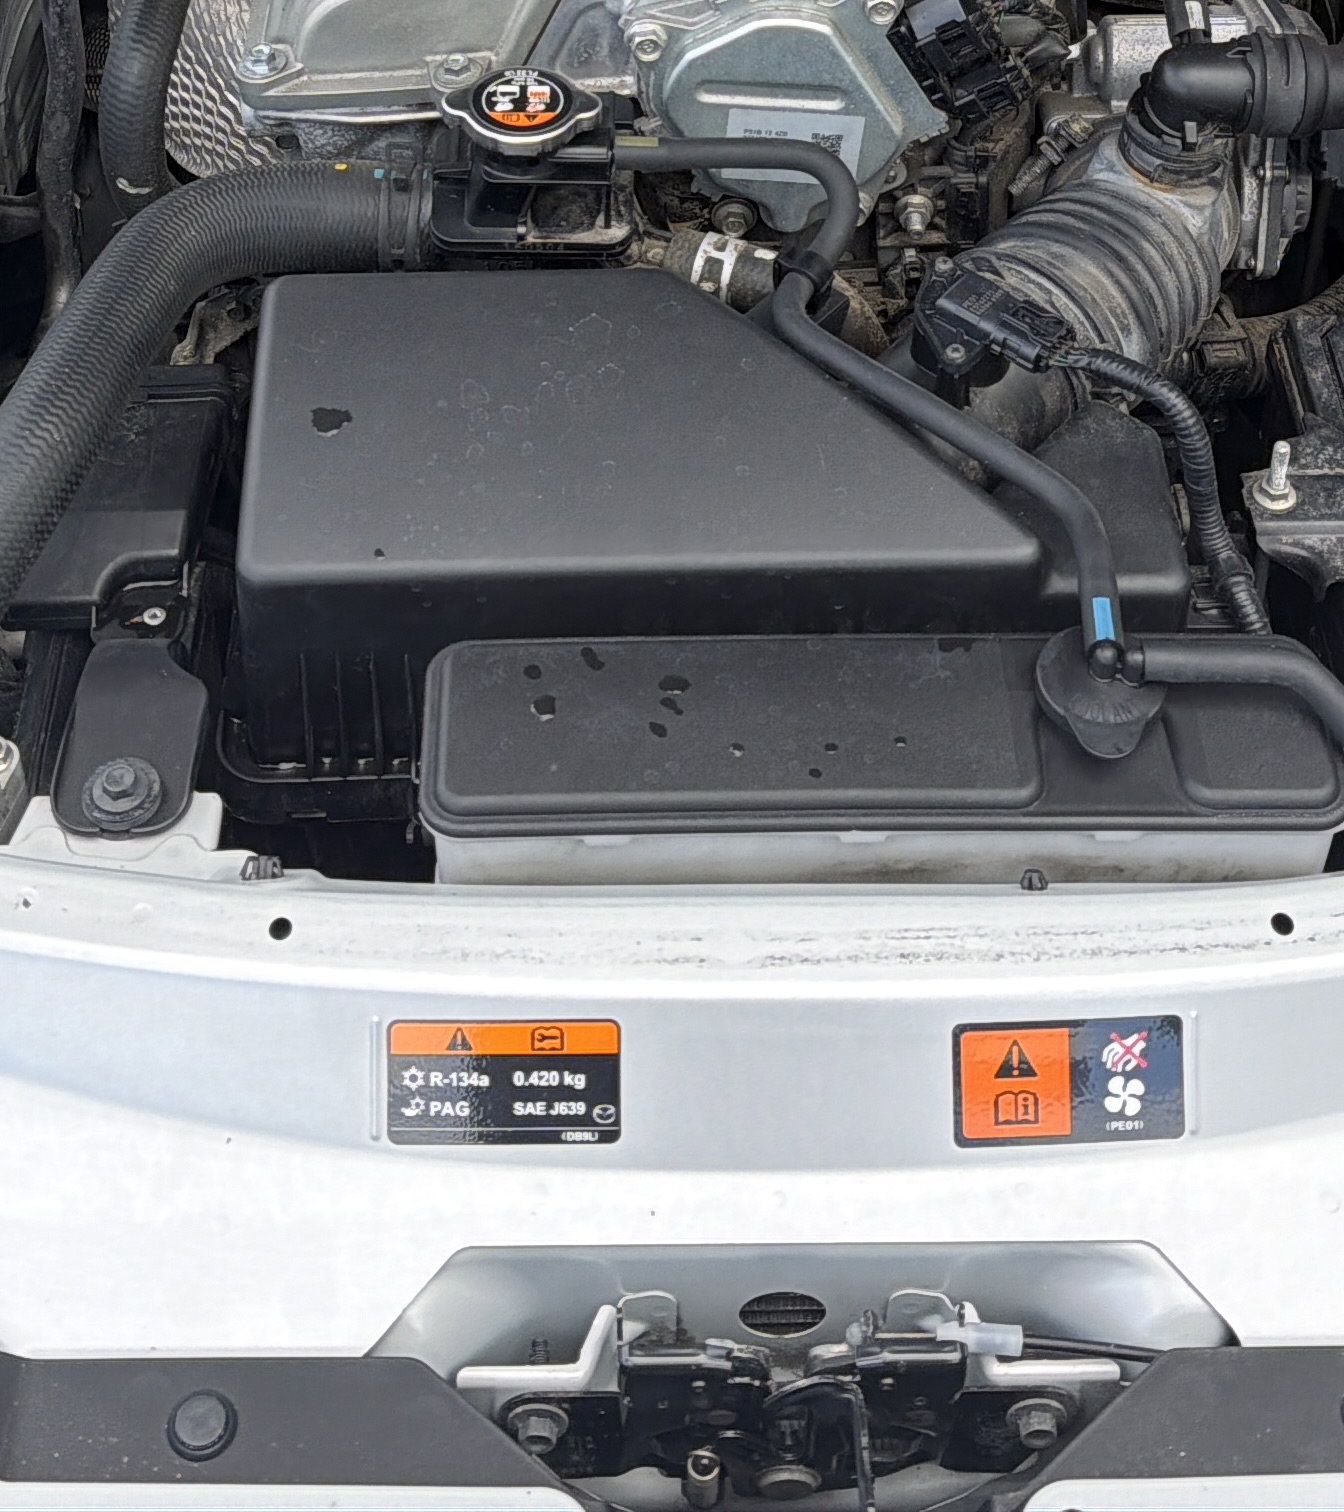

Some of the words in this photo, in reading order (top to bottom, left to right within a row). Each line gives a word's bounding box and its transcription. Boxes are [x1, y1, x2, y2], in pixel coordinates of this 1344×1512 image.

[429, 1071, 491, 1088] R-134a
[512, 1070, 560, 1087] 0.420
[563, 1070, 587, 1090] kg
[429, 1100, 471, 1117] PAG
[512, 1100, 547, 1117] SAE
[549, 1100, 587, 1117] J639
[1106, 1119, 1144, 1131] (PE01)
